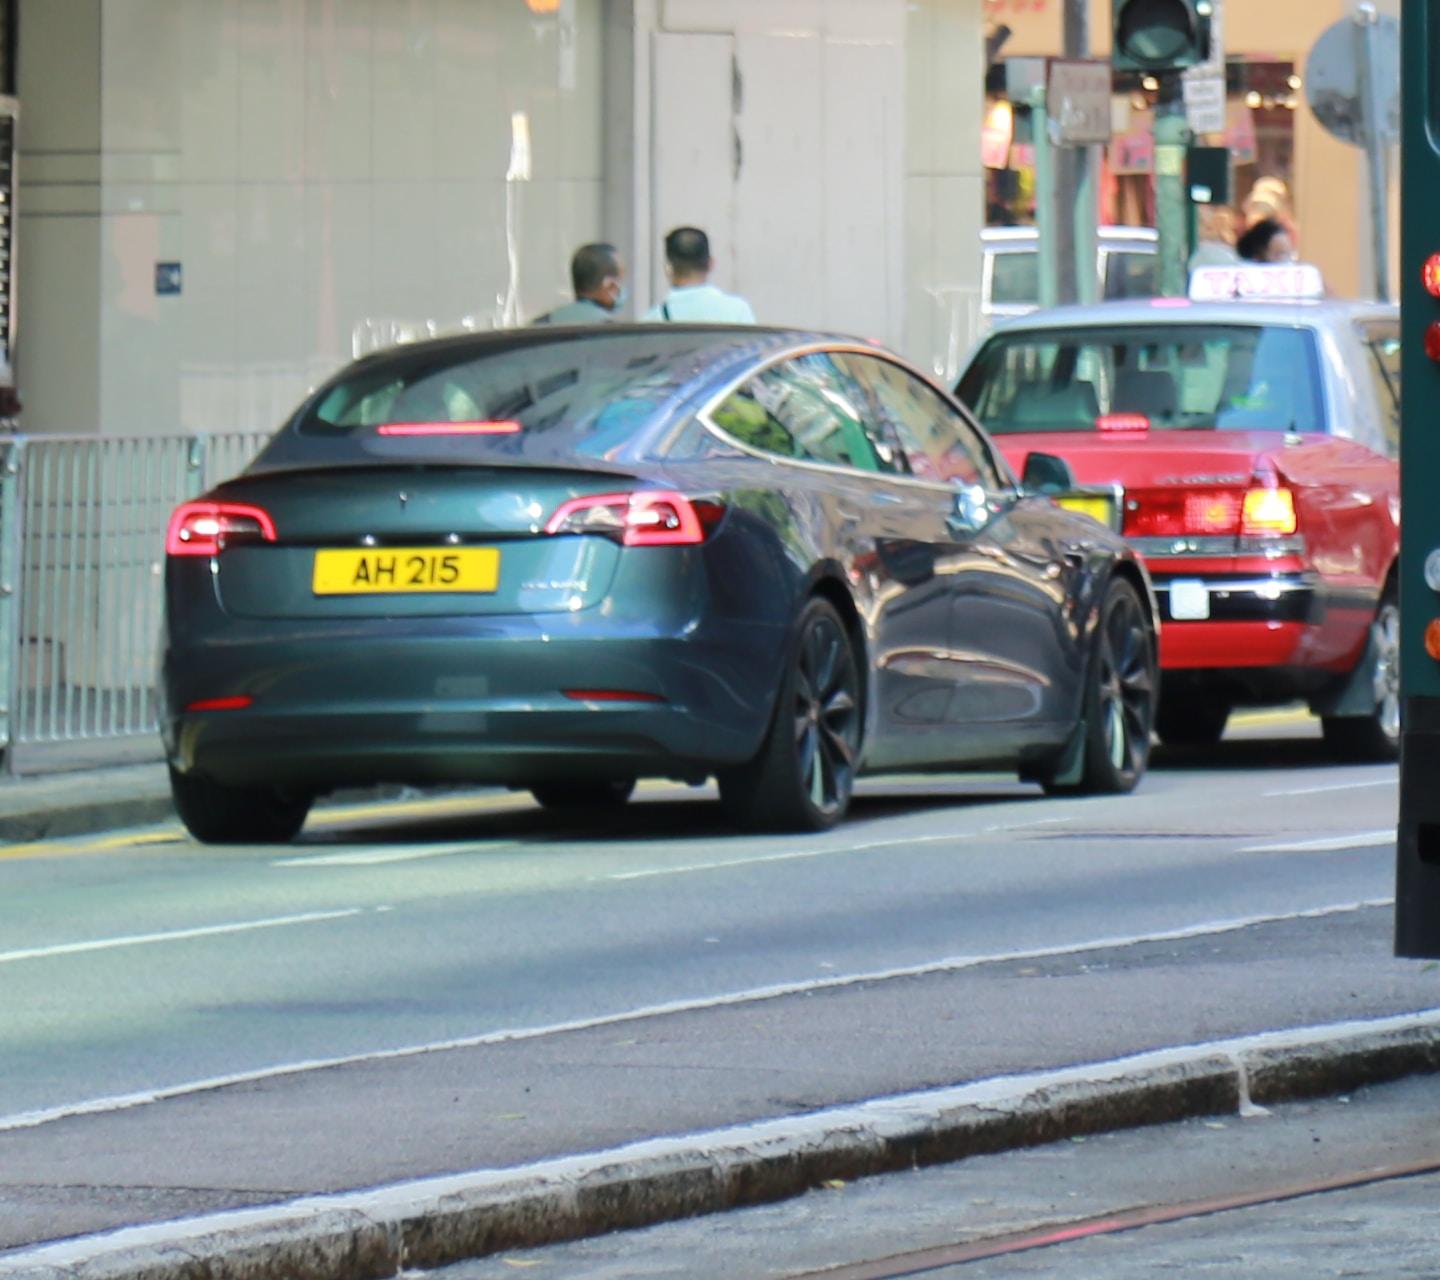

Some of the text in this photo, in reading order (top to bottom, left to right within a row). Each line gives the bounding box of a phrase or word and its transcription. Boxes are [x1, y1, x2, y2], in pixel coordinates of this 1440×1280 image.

[1202, 270, 1307, 295] TAXI
[352, 553, 461, 586] AH 215
